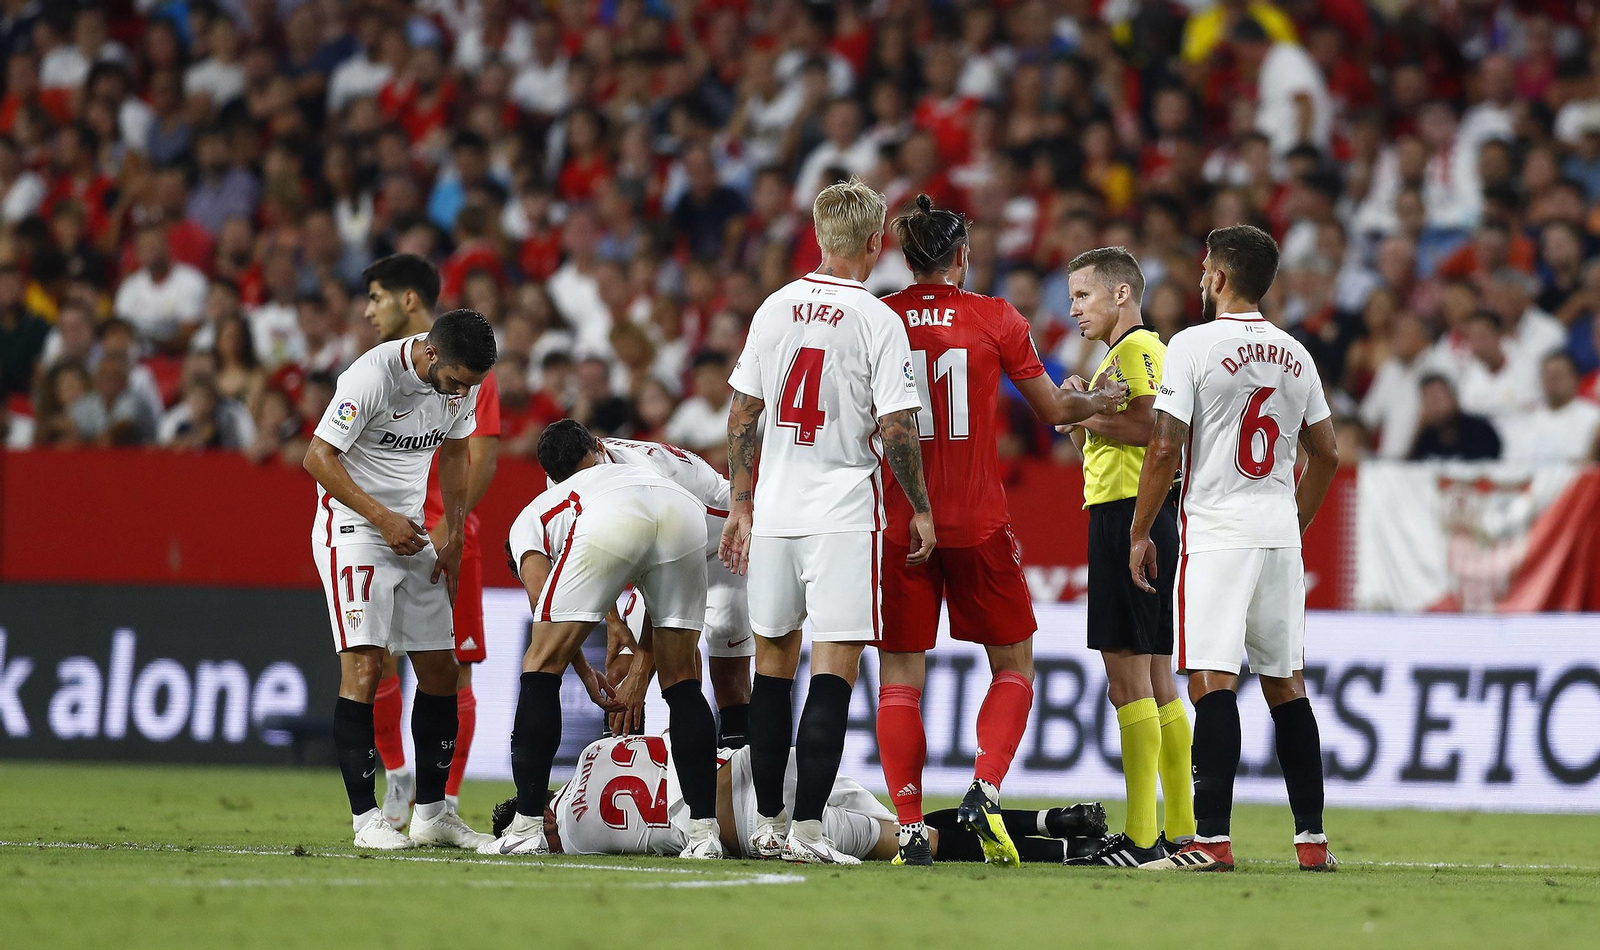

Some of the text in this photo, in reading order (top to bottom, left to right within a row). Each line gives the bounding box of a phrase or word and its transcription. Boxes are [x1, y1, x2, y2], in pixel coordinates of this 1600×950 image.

[792, 303, 844, 328] KJÆR
[906, 308, 956, 328] BALE
[776, 347, 826, 446] 4
[911, 348, 969, 440] 11
[1221, 343, 1302, 378] D.CARRIÇO
[331, 417, 350, 431] LaLiga
[1234, 387, 1280, 480] 6
[340, 565, 375, 603] 17
[47, 655, 309, 747] alone
[571, 744, 606, 823] VAZQUEZ
[600, 737, 671, 830] 22
